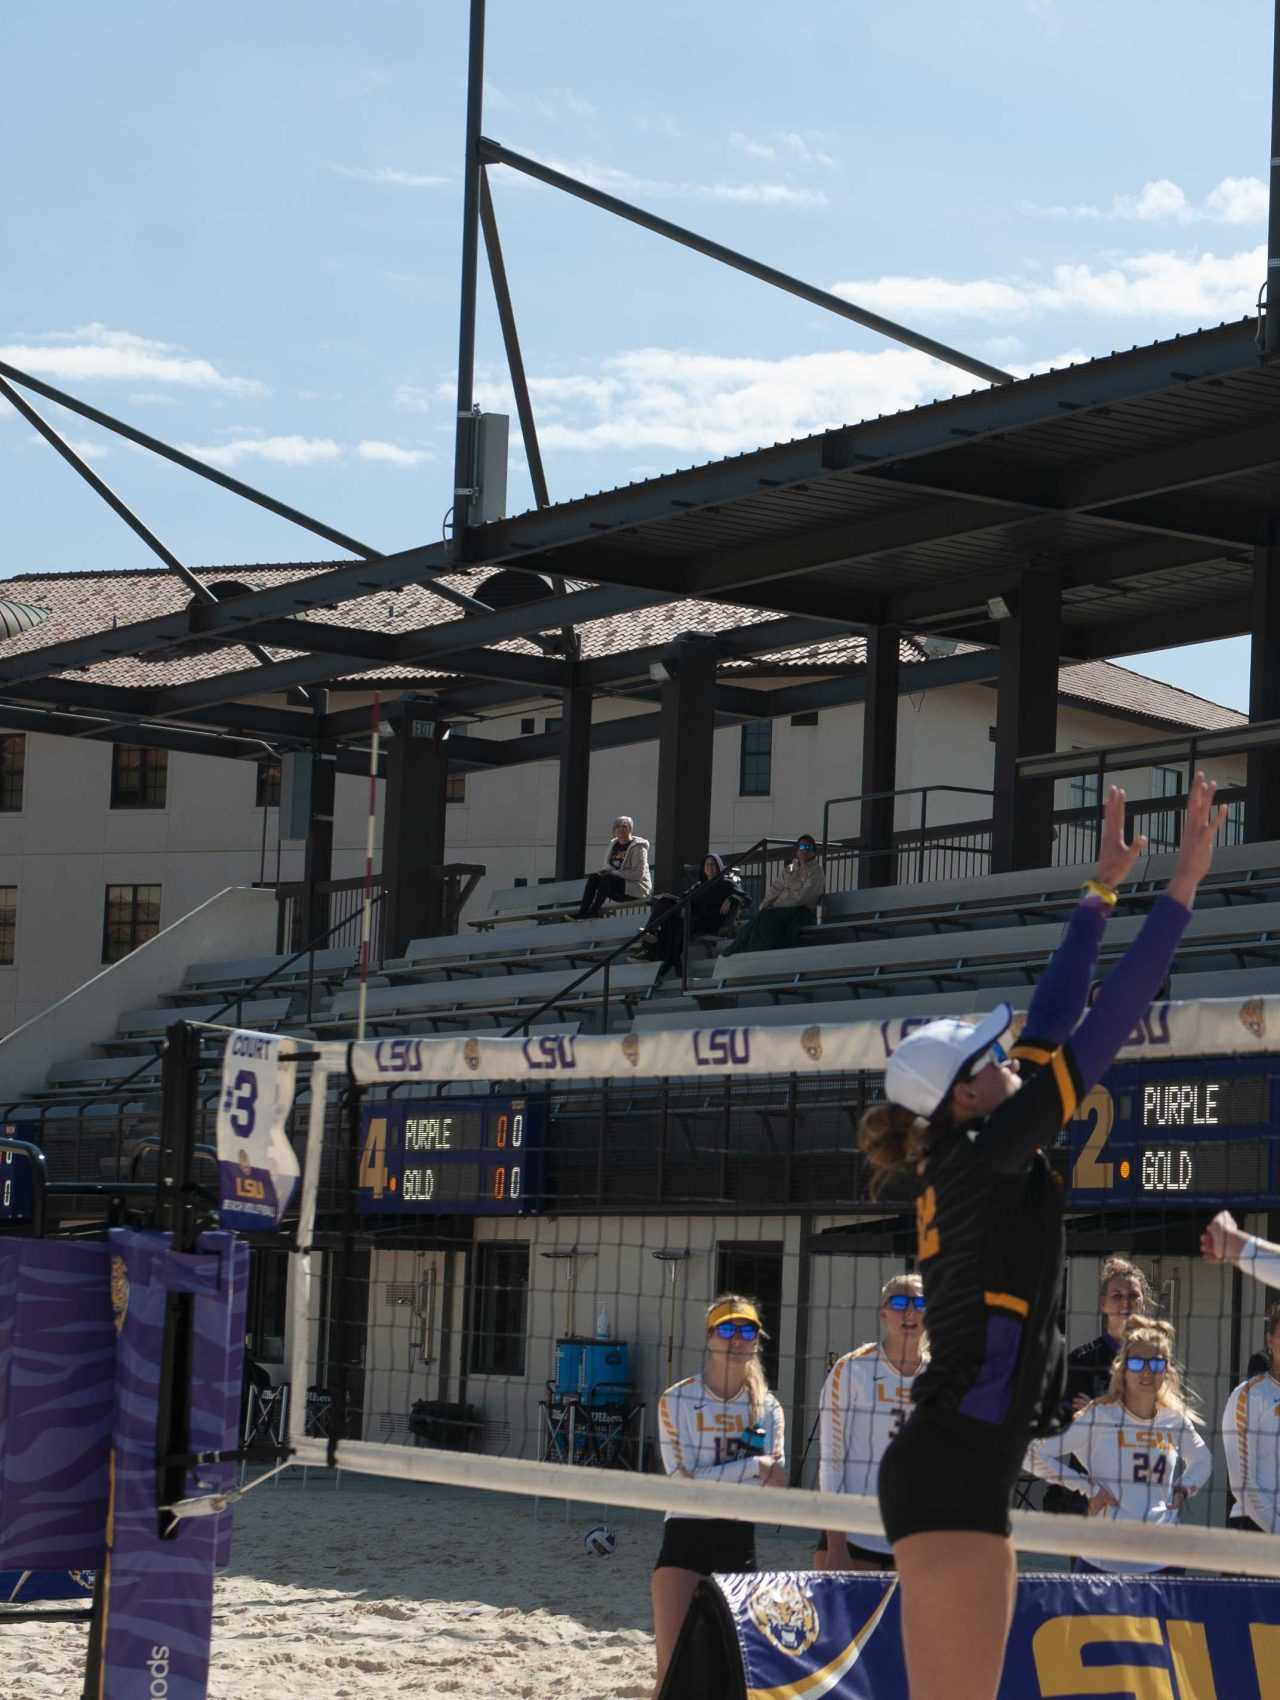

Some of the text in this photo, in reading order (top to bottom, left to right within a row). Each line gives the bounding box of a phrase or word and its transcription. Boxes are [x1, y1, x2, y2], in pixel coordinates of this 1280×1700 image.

[232, 1036, 272, 1061] COURT
[376, 1039, 422, 1072] LSU
[522, 1034, 577, 1069] LSU
[693, 1027, 750, 1066] LSU
[1143, 1084, 1220, 1126] PURPLE
[404, 1118, 453, 1150] PURPLE
[513, 1115, 523, 1147] 0
[1072, 1084, 1114, 1189] 2
[359, 1118, 388, 1199] 4
[1142, 1150, 1193, 1190] GOLD
[235, 1176, 265, 1199] LSU
[403, 1169, 434, 1200] GOLD
[878, 1383, 913, 1404] LS
[1118, 1429, 1174, 1450] LSU
[1131, 1452, 1166, 1484] 24
[147, 1645, 170, 1700] ods
